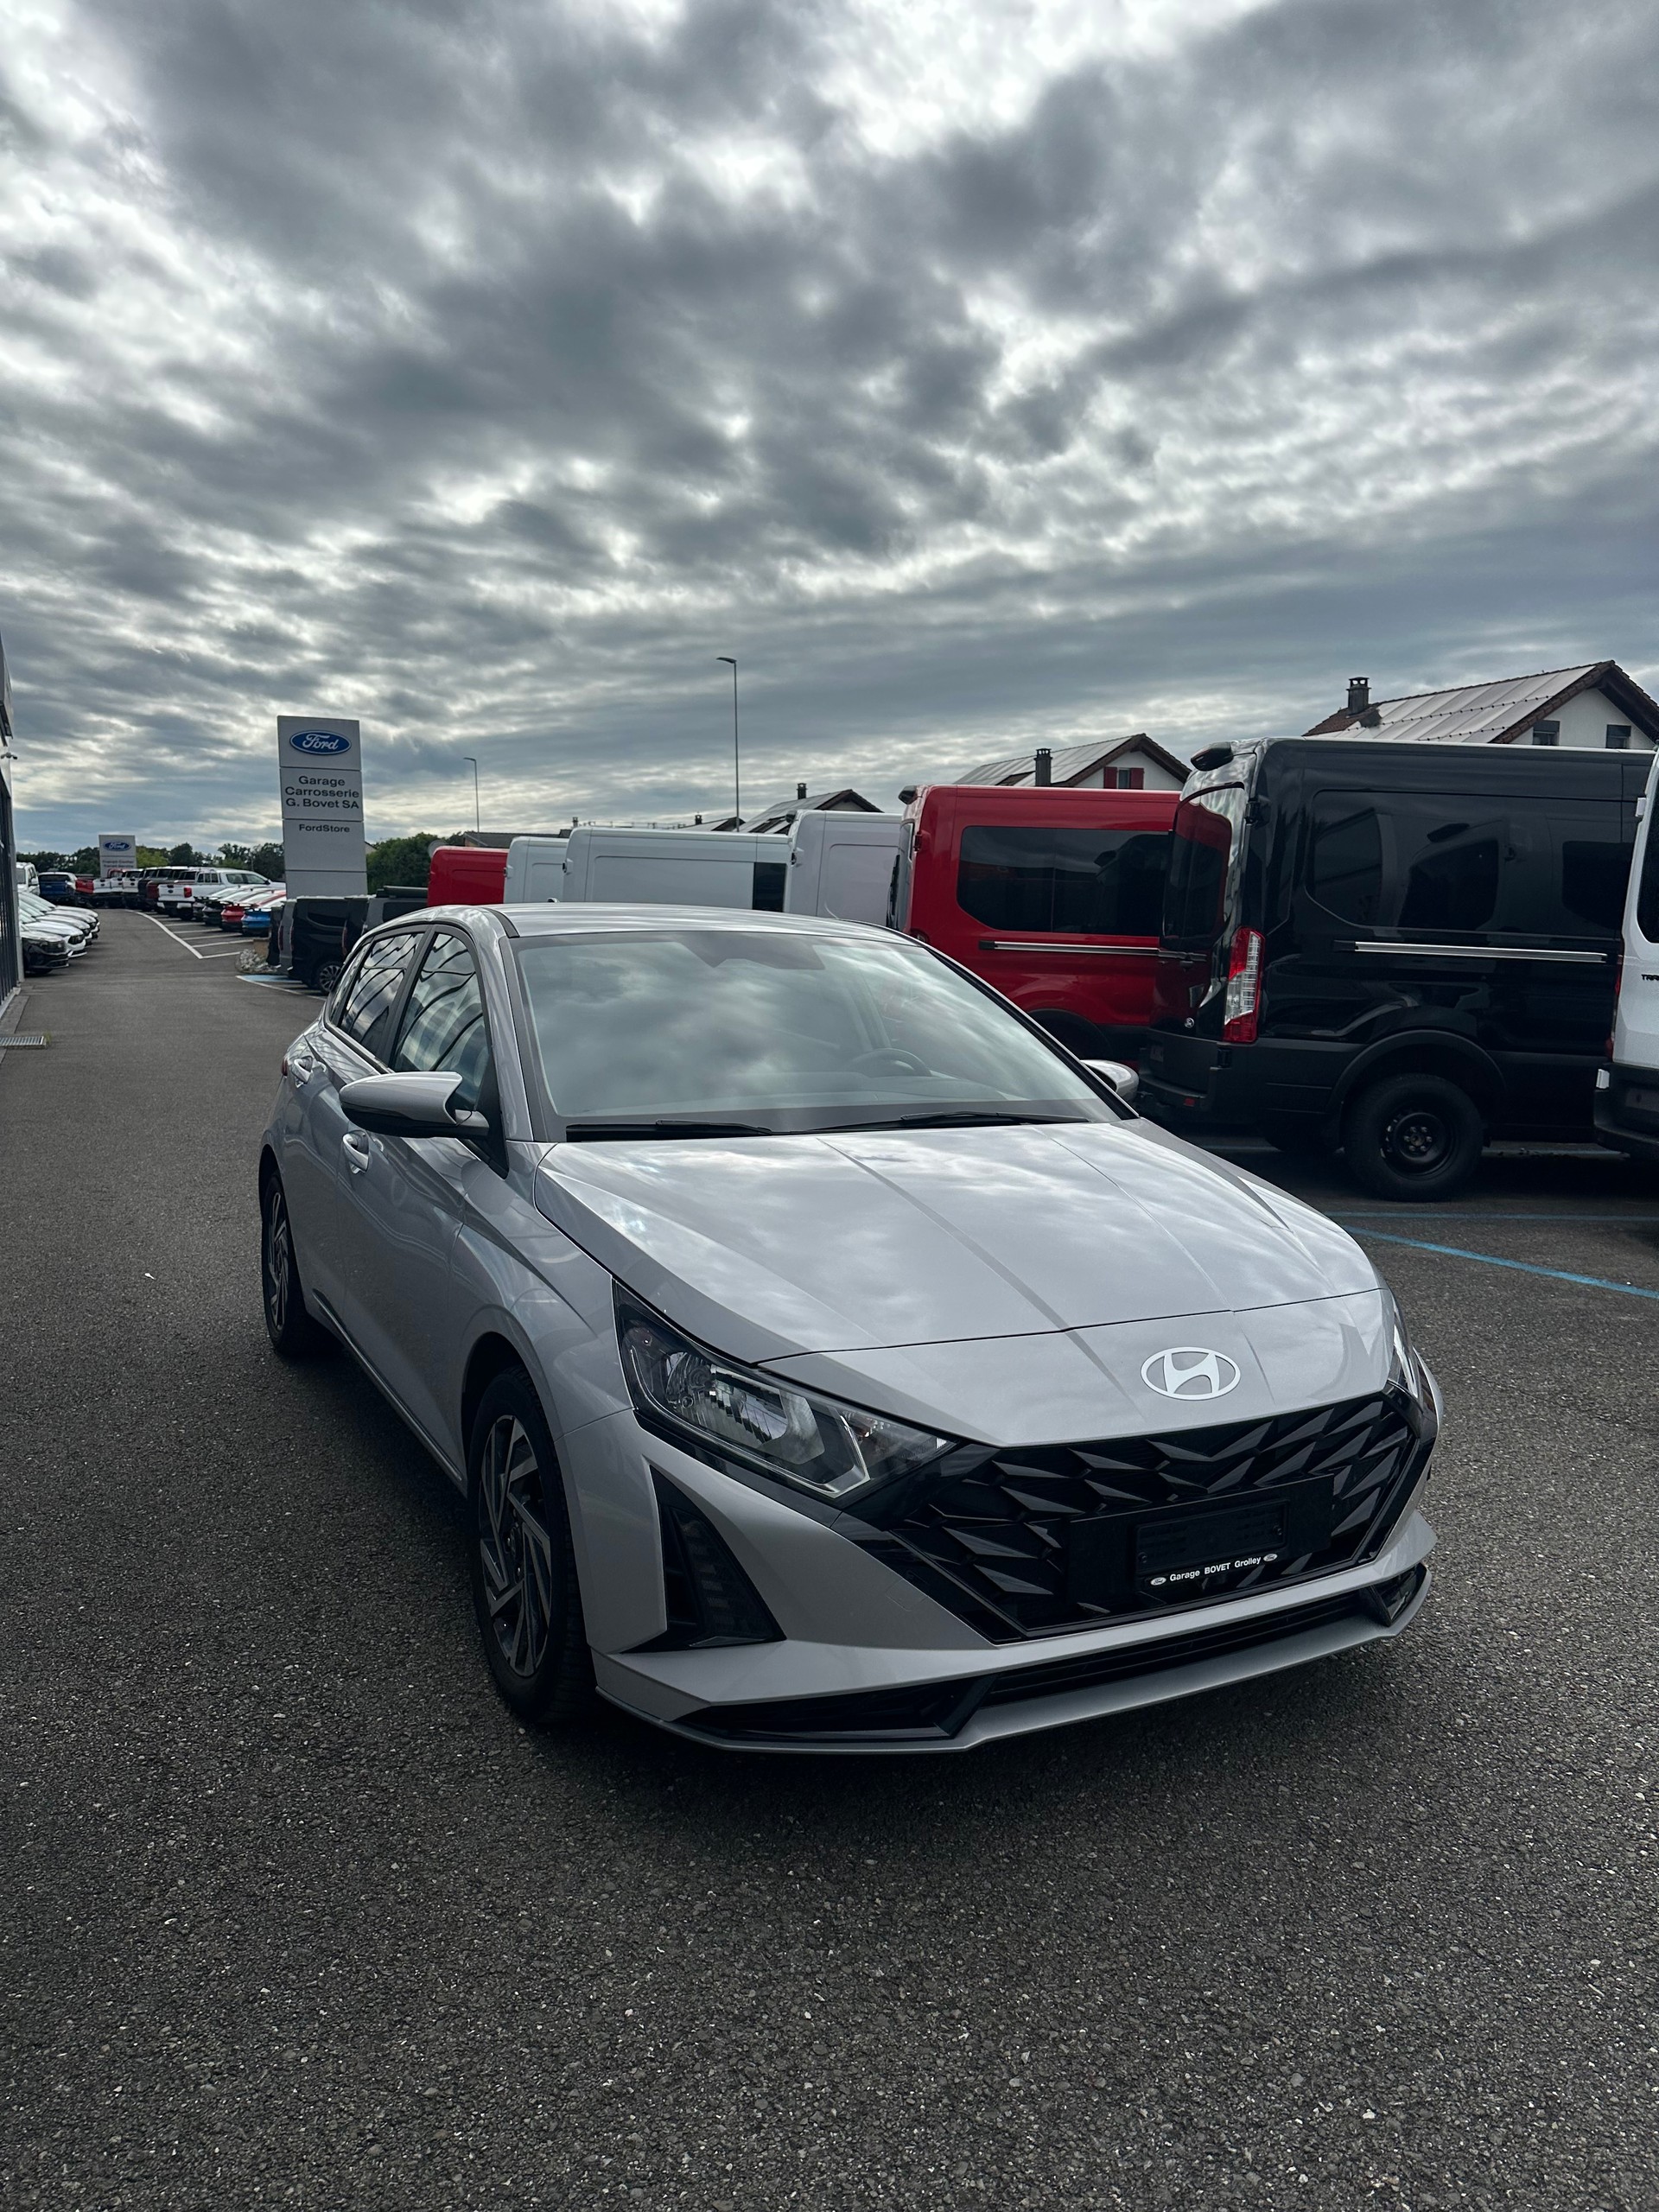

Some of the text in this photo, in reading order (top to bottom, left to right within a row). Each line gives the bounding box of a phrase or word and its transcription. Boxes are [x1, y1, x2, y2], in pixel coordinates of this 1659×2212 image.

[302, 734, 339, 750] Ford
[298, 776, 346, 787] Garage
[285, 786, 359, 798] Carrosserie
[286, 798, 359, 809] G. Bovet SA
[299, 823, 350, 833] FordStore
[1169, 1570, 1201, 1581] Garage
[1204, 1562, 1231, 1574] BOVET
[1234, 1556, 1262, 1568] Grolley
